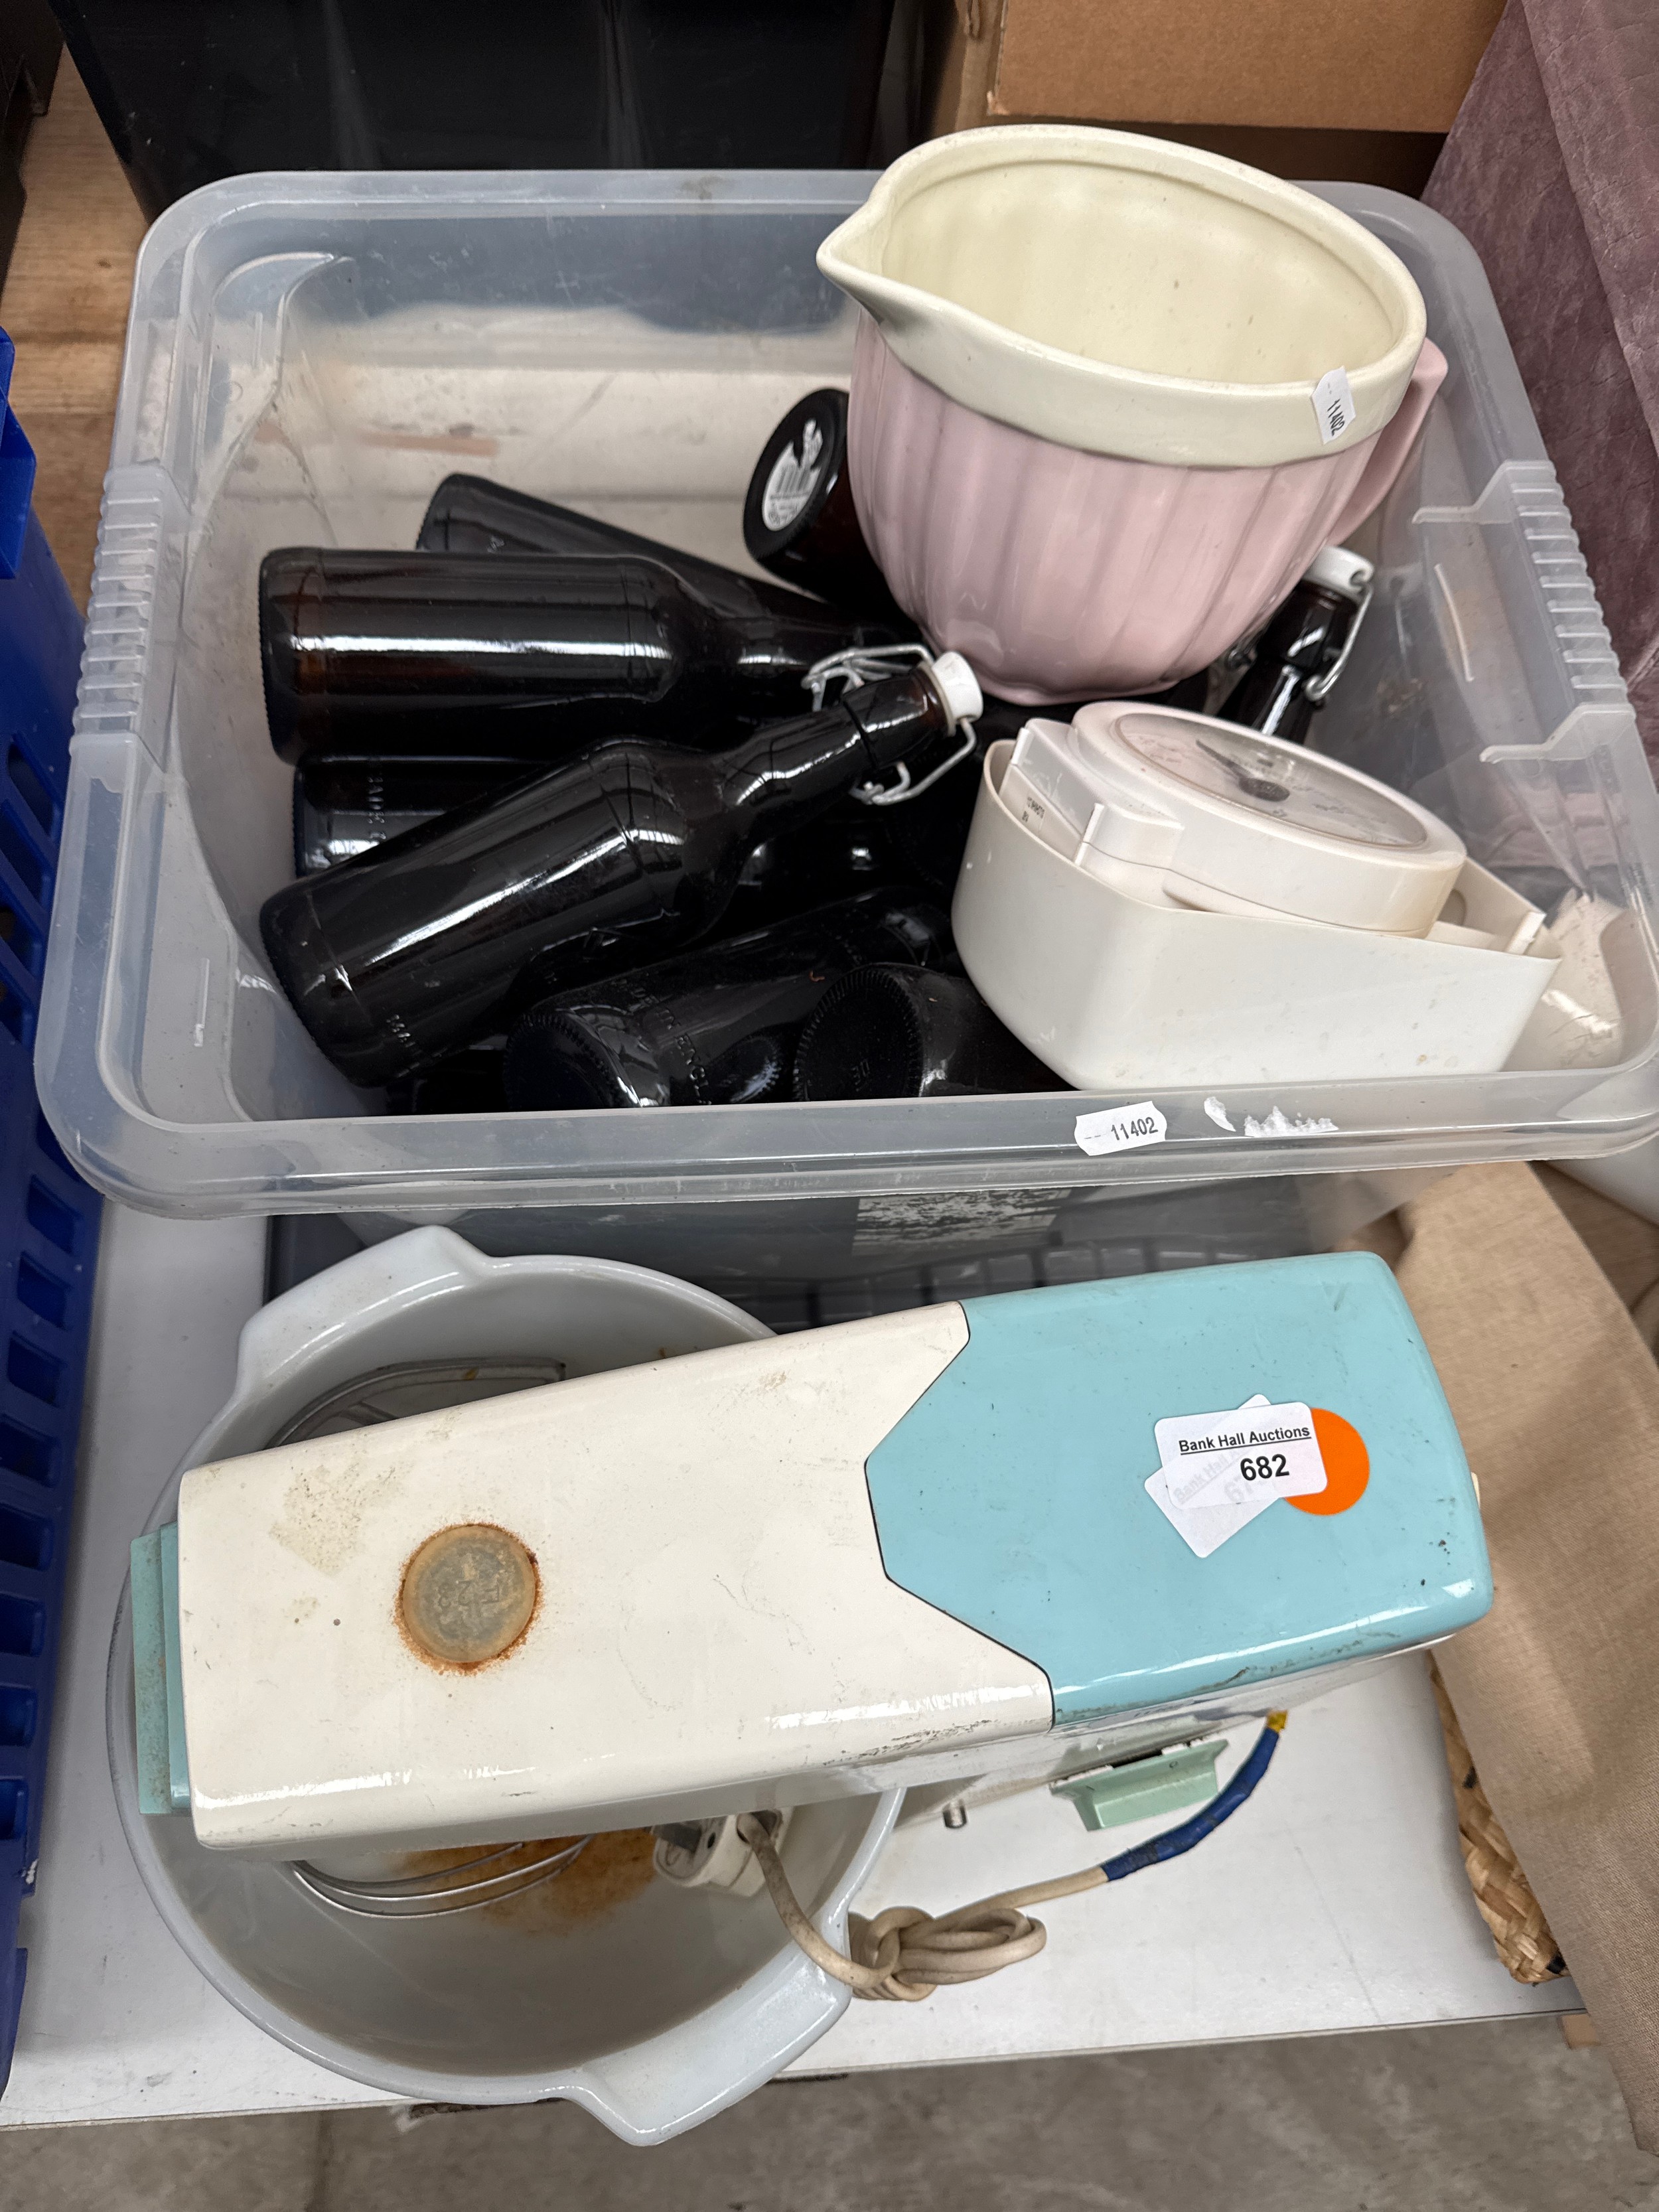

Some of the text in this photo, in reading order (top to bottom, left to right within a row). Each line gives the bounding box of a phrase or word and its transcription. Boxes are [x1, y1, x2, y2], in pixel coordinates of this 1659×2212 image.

[1327, 398, 1345, 436] 11402
[1111, 1116, 1159, 1142] 11402
[1179, 1436, 1215, 1453] Bank
[1218, 1433, 1245, 1447] Hall
[1249, 1426, 1310, 1445] Auctions
[1240, 1453, 1290, 1481] 682
